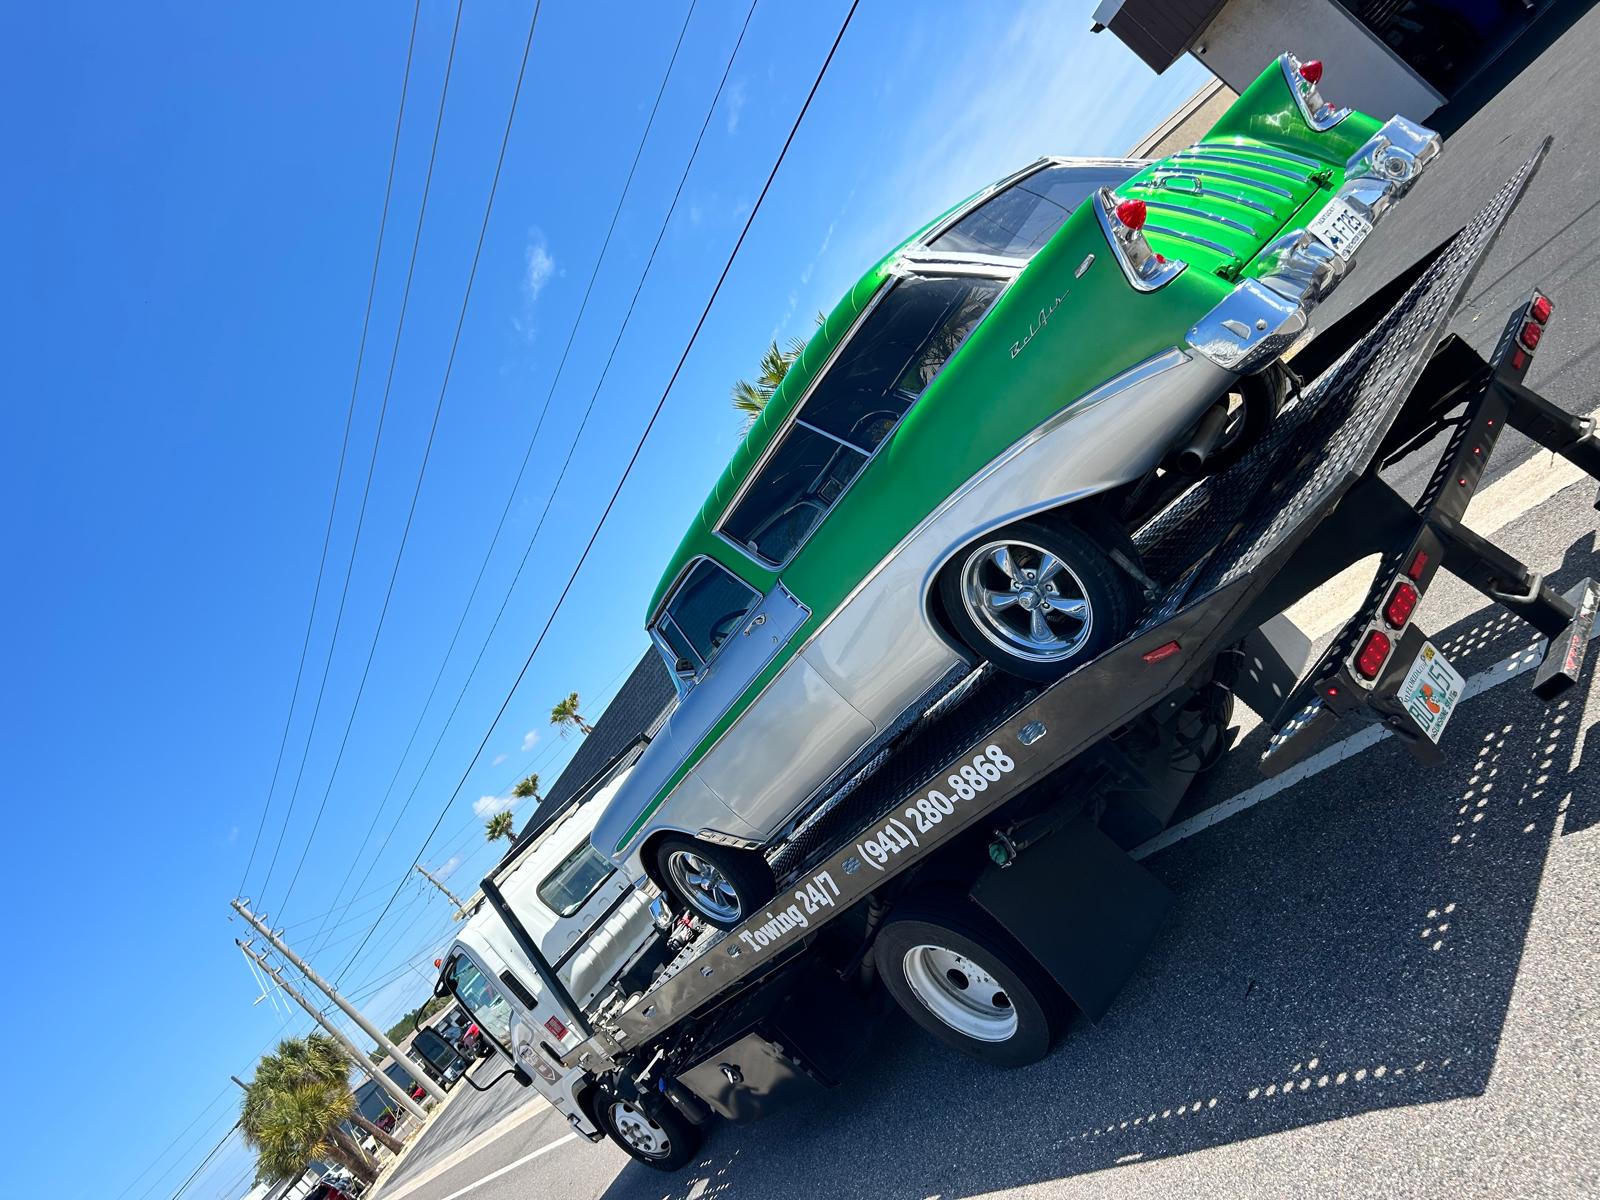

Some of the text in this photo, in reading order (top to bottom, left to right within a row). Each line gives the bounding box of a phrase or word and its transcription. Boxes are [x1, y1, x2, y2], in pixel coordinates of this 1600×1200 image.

[1332, 209, 1361, 241] F-725
[739, 744, 1015, 952] Towing 24/7 (941) 280-8868
